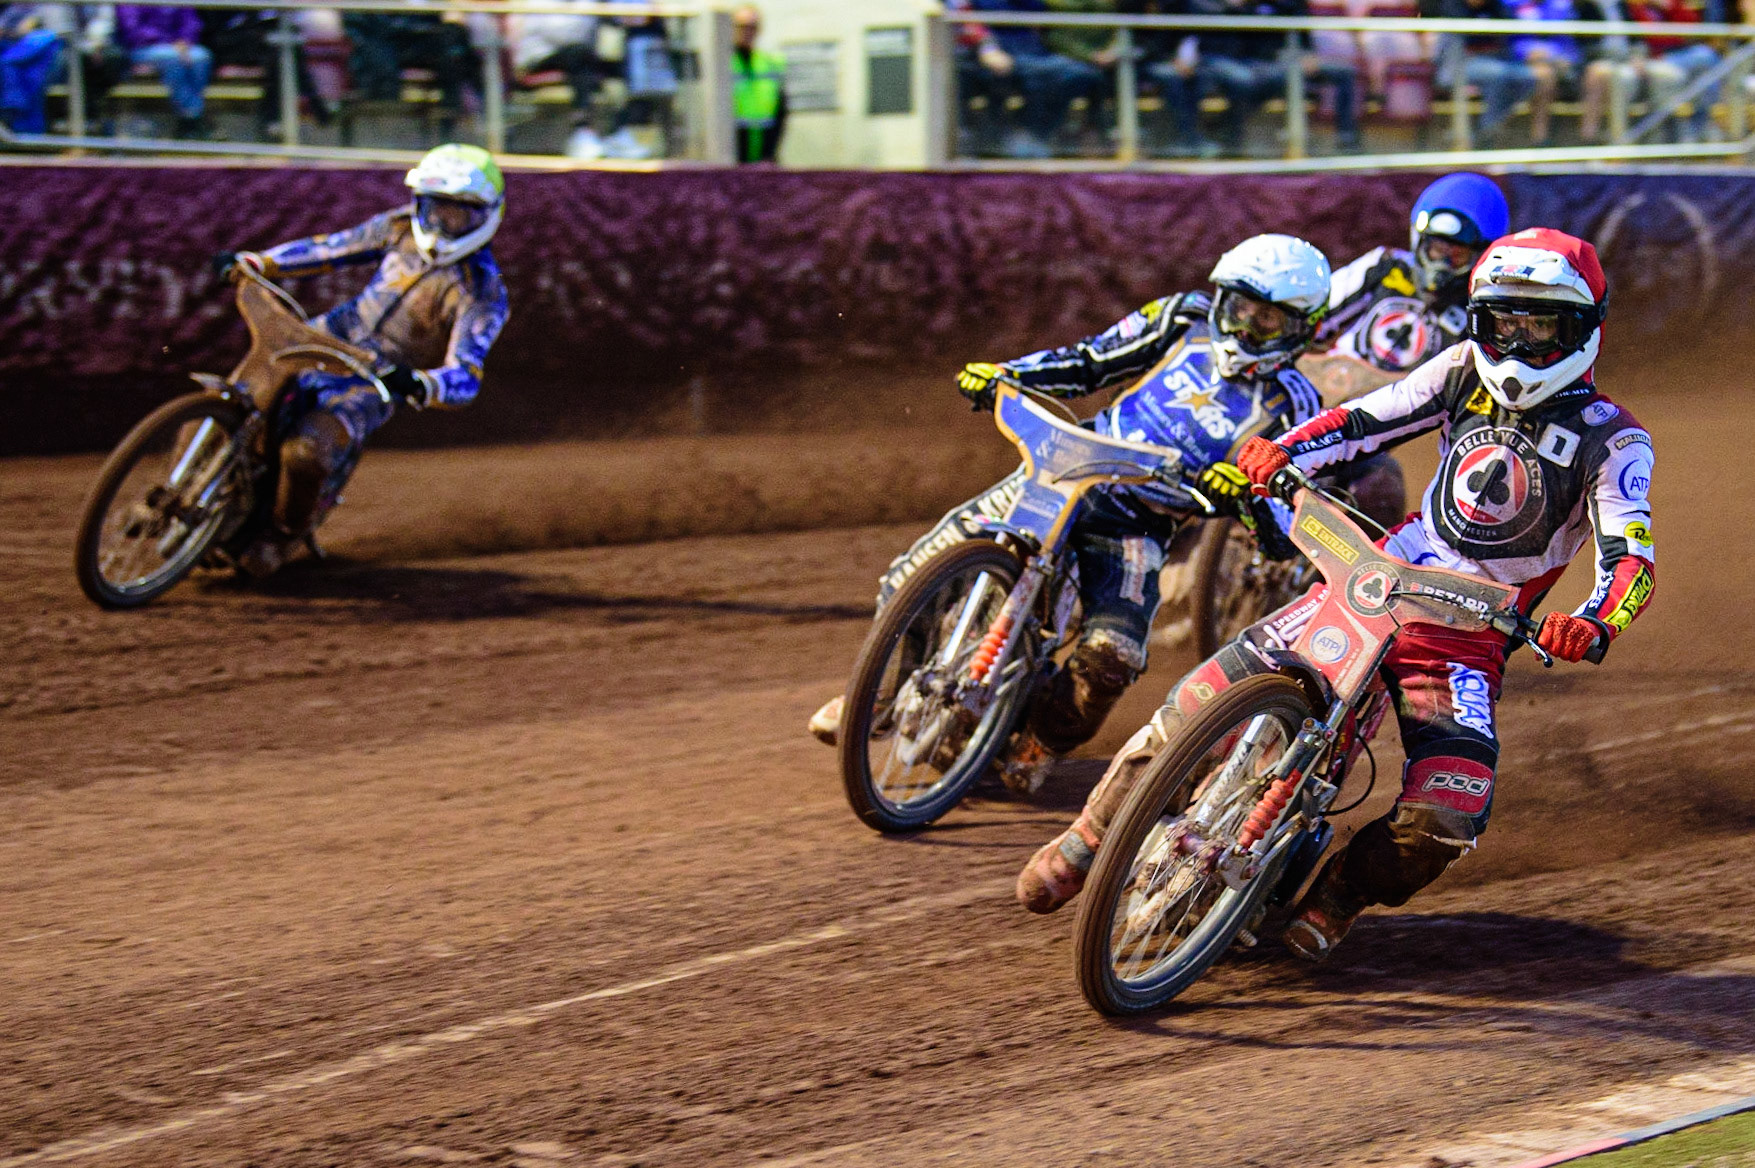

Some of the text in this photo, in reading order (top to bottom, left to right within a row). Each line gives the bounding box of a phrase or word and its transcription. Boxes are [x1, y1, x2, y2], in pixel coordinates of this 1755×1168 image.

[1457, 431, 1542, 497] BELLE VUE ACES
[1272, 599, 1318, 629] SPEEDWAY
[1317, 636, 1342, 654] ATPI
[1422, 771, 1490, 797] pod
